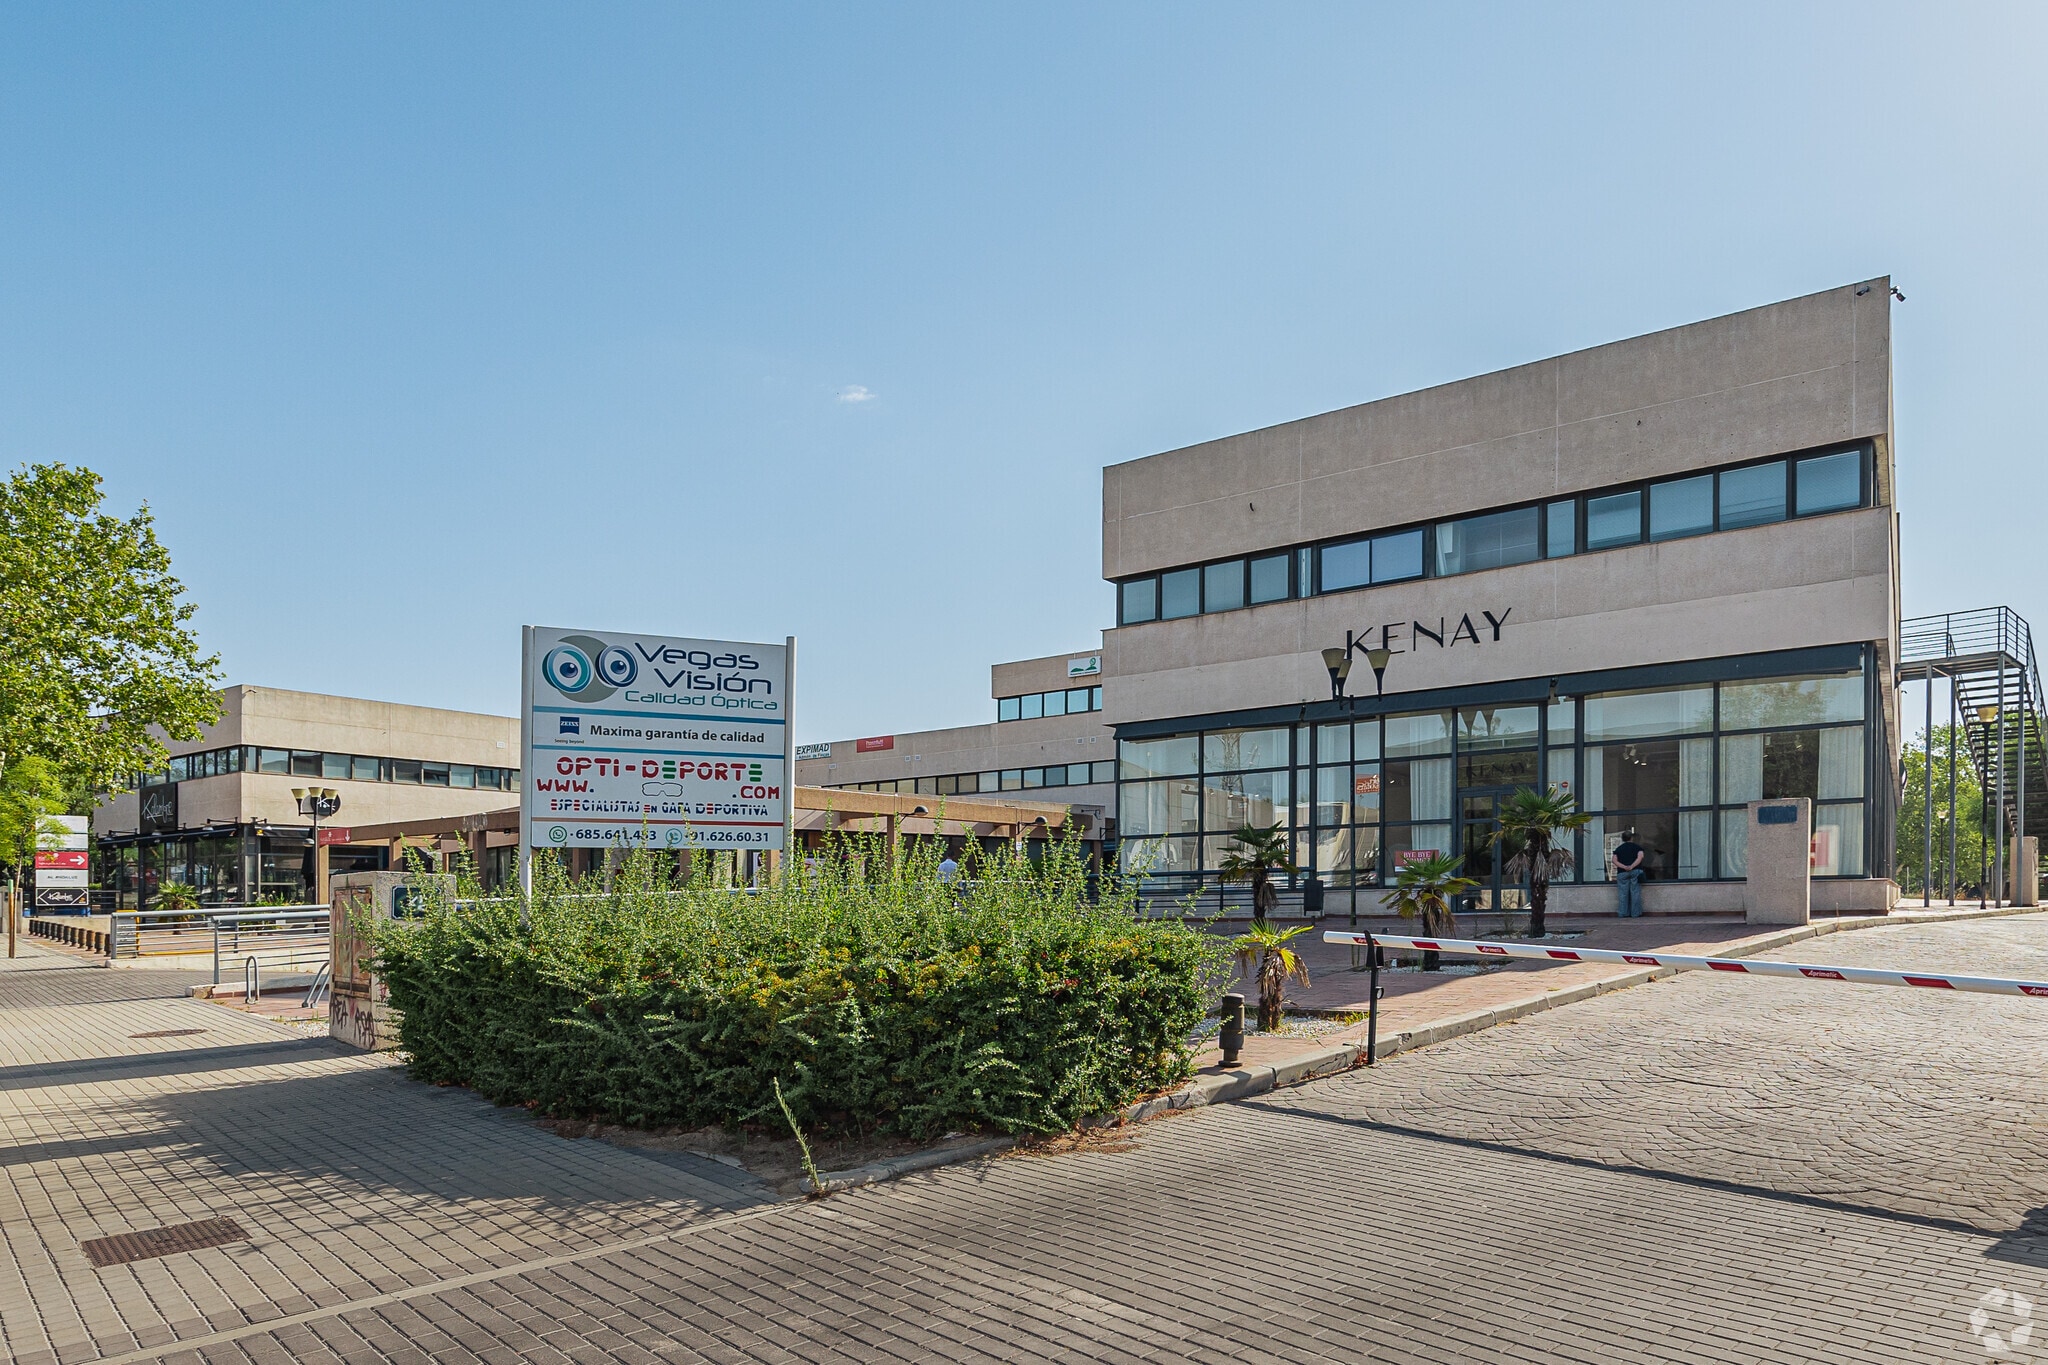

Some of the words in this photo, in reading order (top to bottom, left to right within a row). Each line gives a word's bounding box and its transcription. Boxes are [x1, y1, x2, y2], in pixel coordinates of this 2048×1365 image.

[1346, 607, 1512, 660] KENAY
[634, 642, 759, 670] Vegas
[654, 668, 771, 694] Visión
[625, 690, 705, 705] Calidad
[711, 693, 778, 710] Óptica
[590, 725, 641, 737] Maxima
[645, 729, 699, 741] garantía
[701, 730, 718, 741] de
[720, 731, 764, 743] calidad
[796, 743, 830, 755] EXPIMAD
[550, 799, 640, 813] ESPECIALISTAS
[661, 802, 691, 814] GAFA
[695, 803, 768, 816] DEPORTIVA
[1807, 970, 1838, 978] Aprimatic
